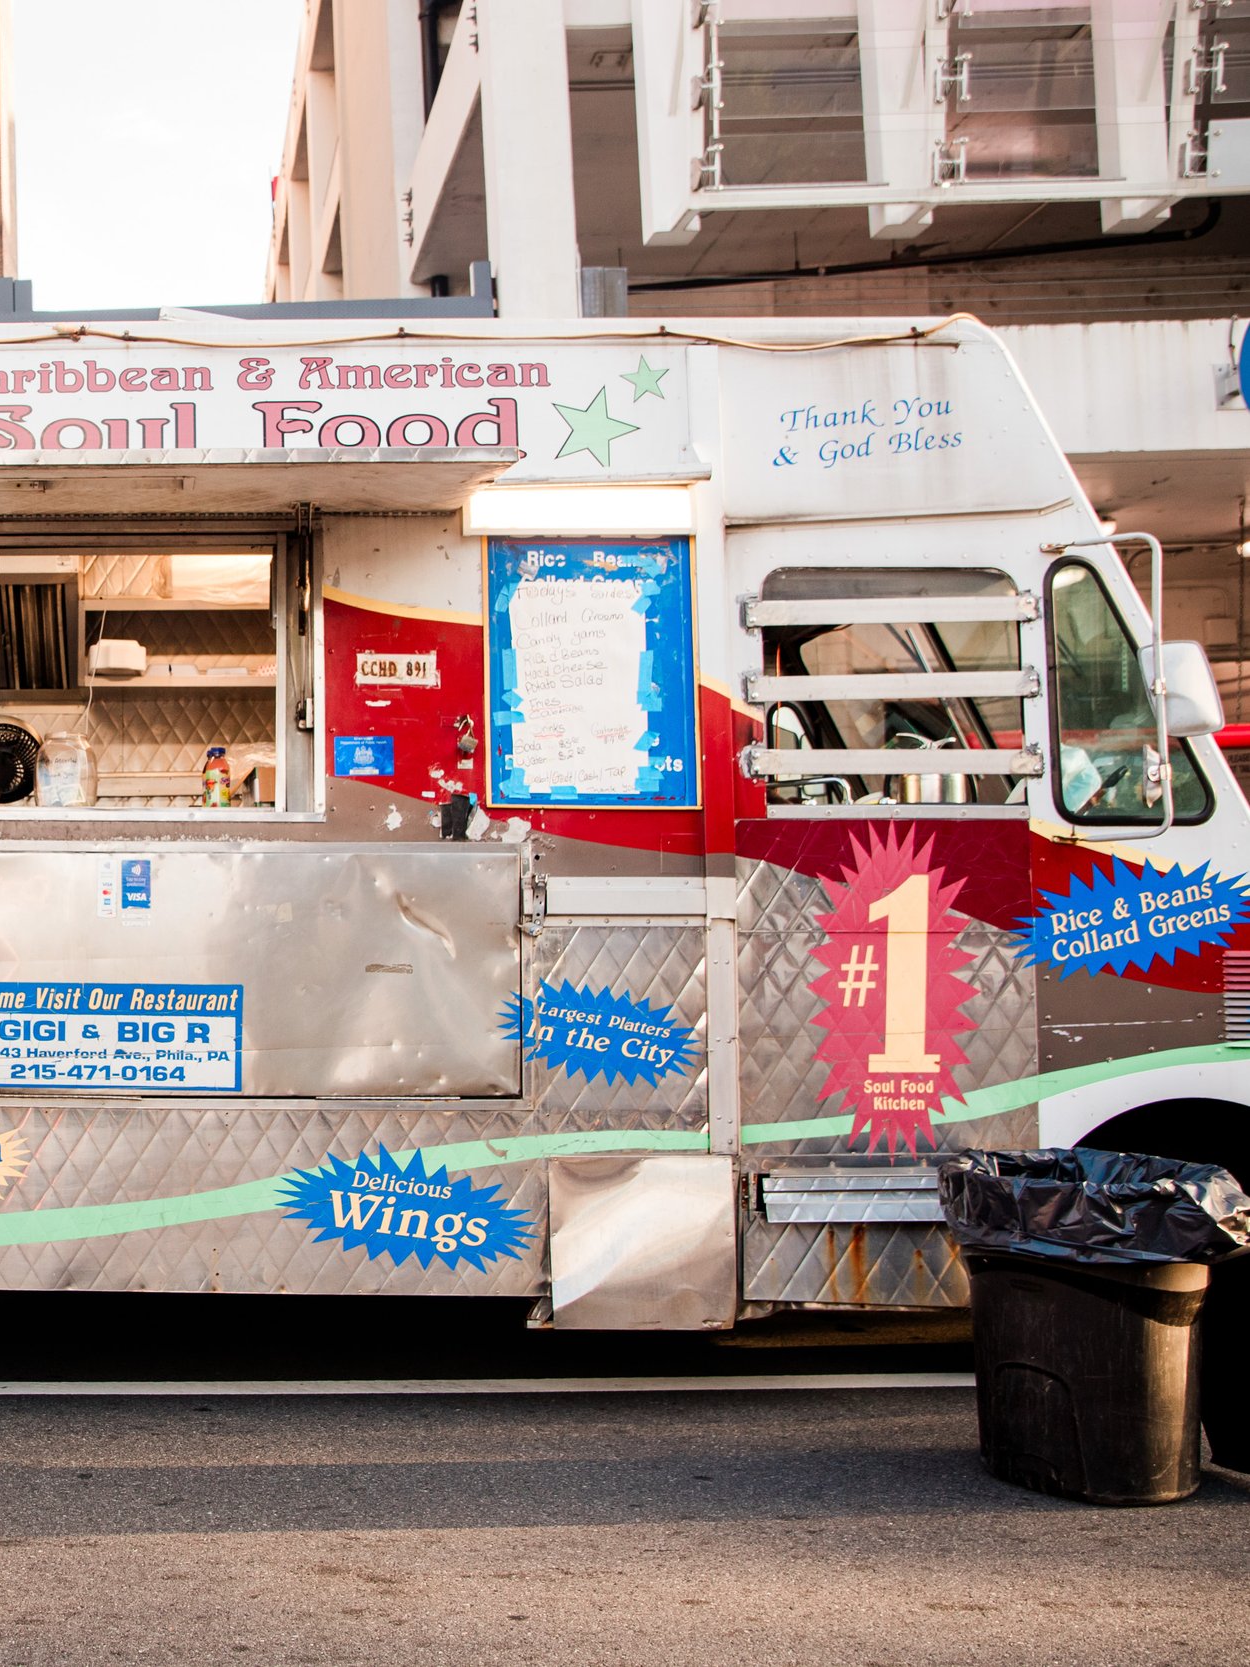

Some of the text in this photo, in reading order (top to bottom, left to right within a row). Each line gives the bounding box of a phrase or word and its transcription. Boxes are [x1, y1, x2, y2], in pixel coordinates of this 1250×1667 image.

[236, 357, 277, 392] &
[299, 356, 552, 391] American
[252, 398, 525, 454] Food
[780, 397, 953, 432] Thank You
[772, 427, 963, 469] & God Bless
[592, 551, 642, 567] Bea
[361, 660, 428, 677] CCHD 891
[126, 893, 147, 901] VISA
[1050, 881, 1213, 936] Rice & Beans
[1052, 904, 1231, 961] Collard Greens
[36, 986, 81, 1010] Visit
[88, 988, 123, 1010] Our
[130, 987, 239, 1011] Restaurant
[81, 1023, 100, 1039] &
[117, 1021, 175, 1043] BIG
[186, 1022, 211, 1043] R
[538, 1002, 671, 1039] Largest Platters
[26, 1048, 107, 1060] Haverford
[207, 1050, 230, 1062] PA
[525, 1019, 676, 1069] In the City
[10, 1063, 186, 1082] 215-471-0164
[863, 1080, 934, 1093] Soul Food
[873, 1096, 925, 1110] Kitchen
[351, 1170, 452, 1199] Delicious
[329, 1190, 490, 1253] Wings
